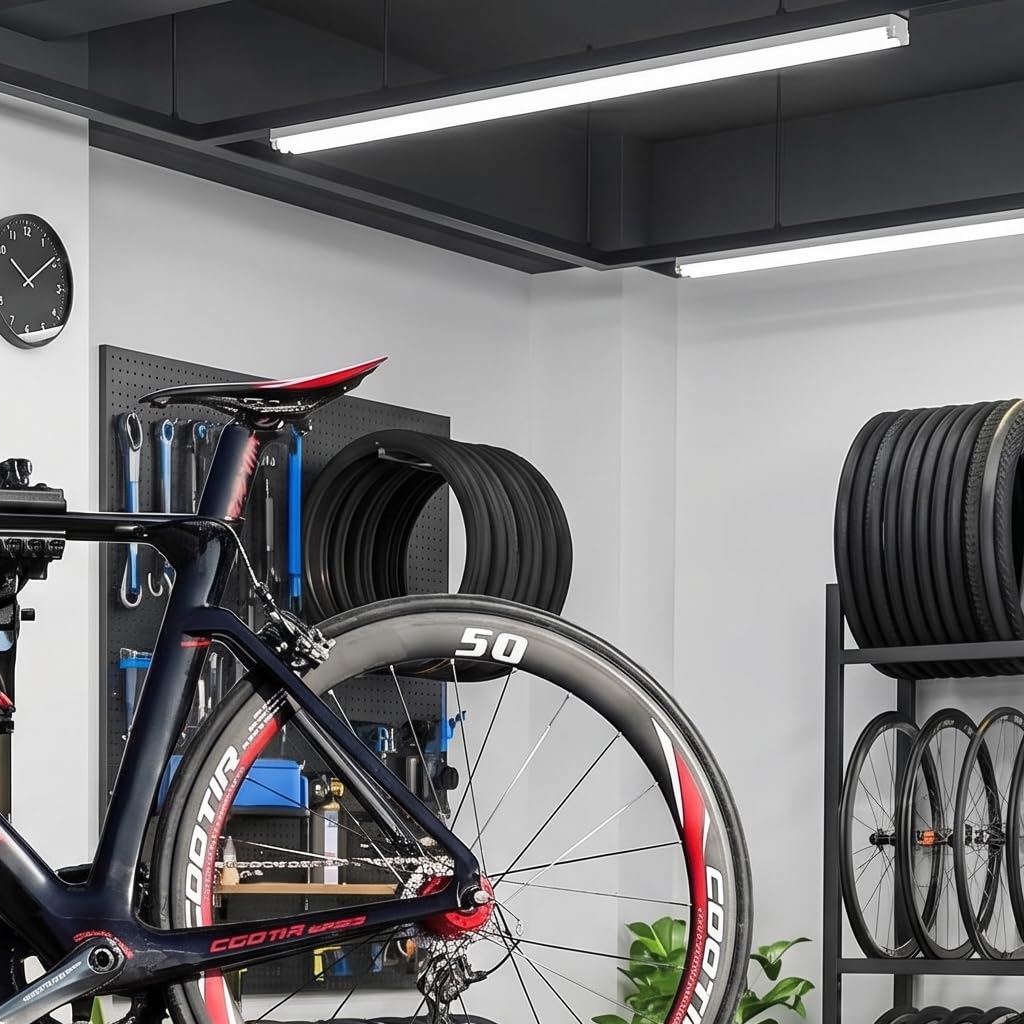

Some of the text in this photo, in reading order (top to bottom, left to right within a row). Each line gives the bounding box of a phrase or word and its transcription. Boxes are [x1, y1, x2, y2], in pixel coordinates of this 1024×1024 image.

[9, 230, 17, 240] 11
[23, 226, 32, 237] 12
[454, 627, 528, 665] 50
